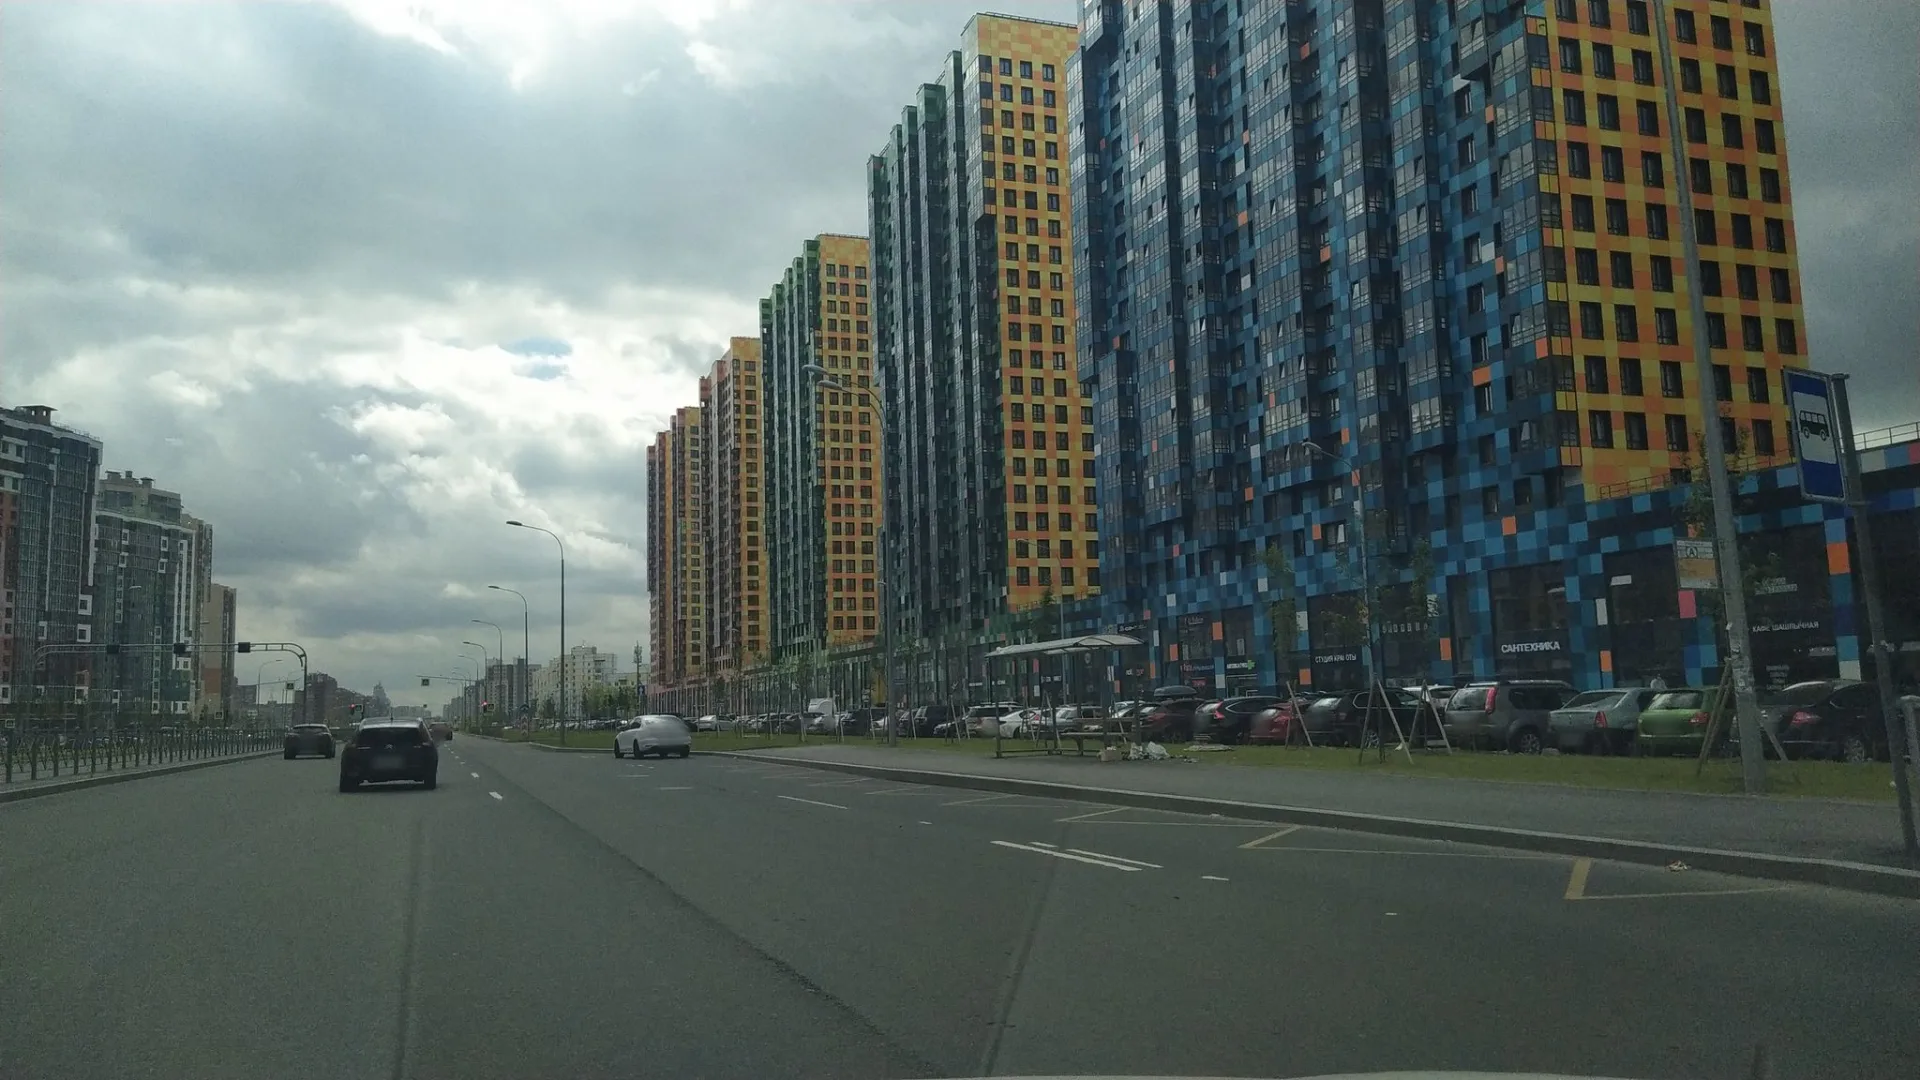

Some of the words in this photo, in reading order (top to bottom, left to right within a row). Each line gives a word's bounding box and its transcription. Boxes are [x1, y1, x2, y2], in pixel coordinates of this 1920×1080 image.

[1752, 624, 1771, 633] КАФЕ
[1772, 620, 1820, 632] ШАШЛЫЧНАЯ
[1501, 641, 1561, 653] САНТЕХНИКА
[1314, 654, 1333, 663] СТУДИЯ
